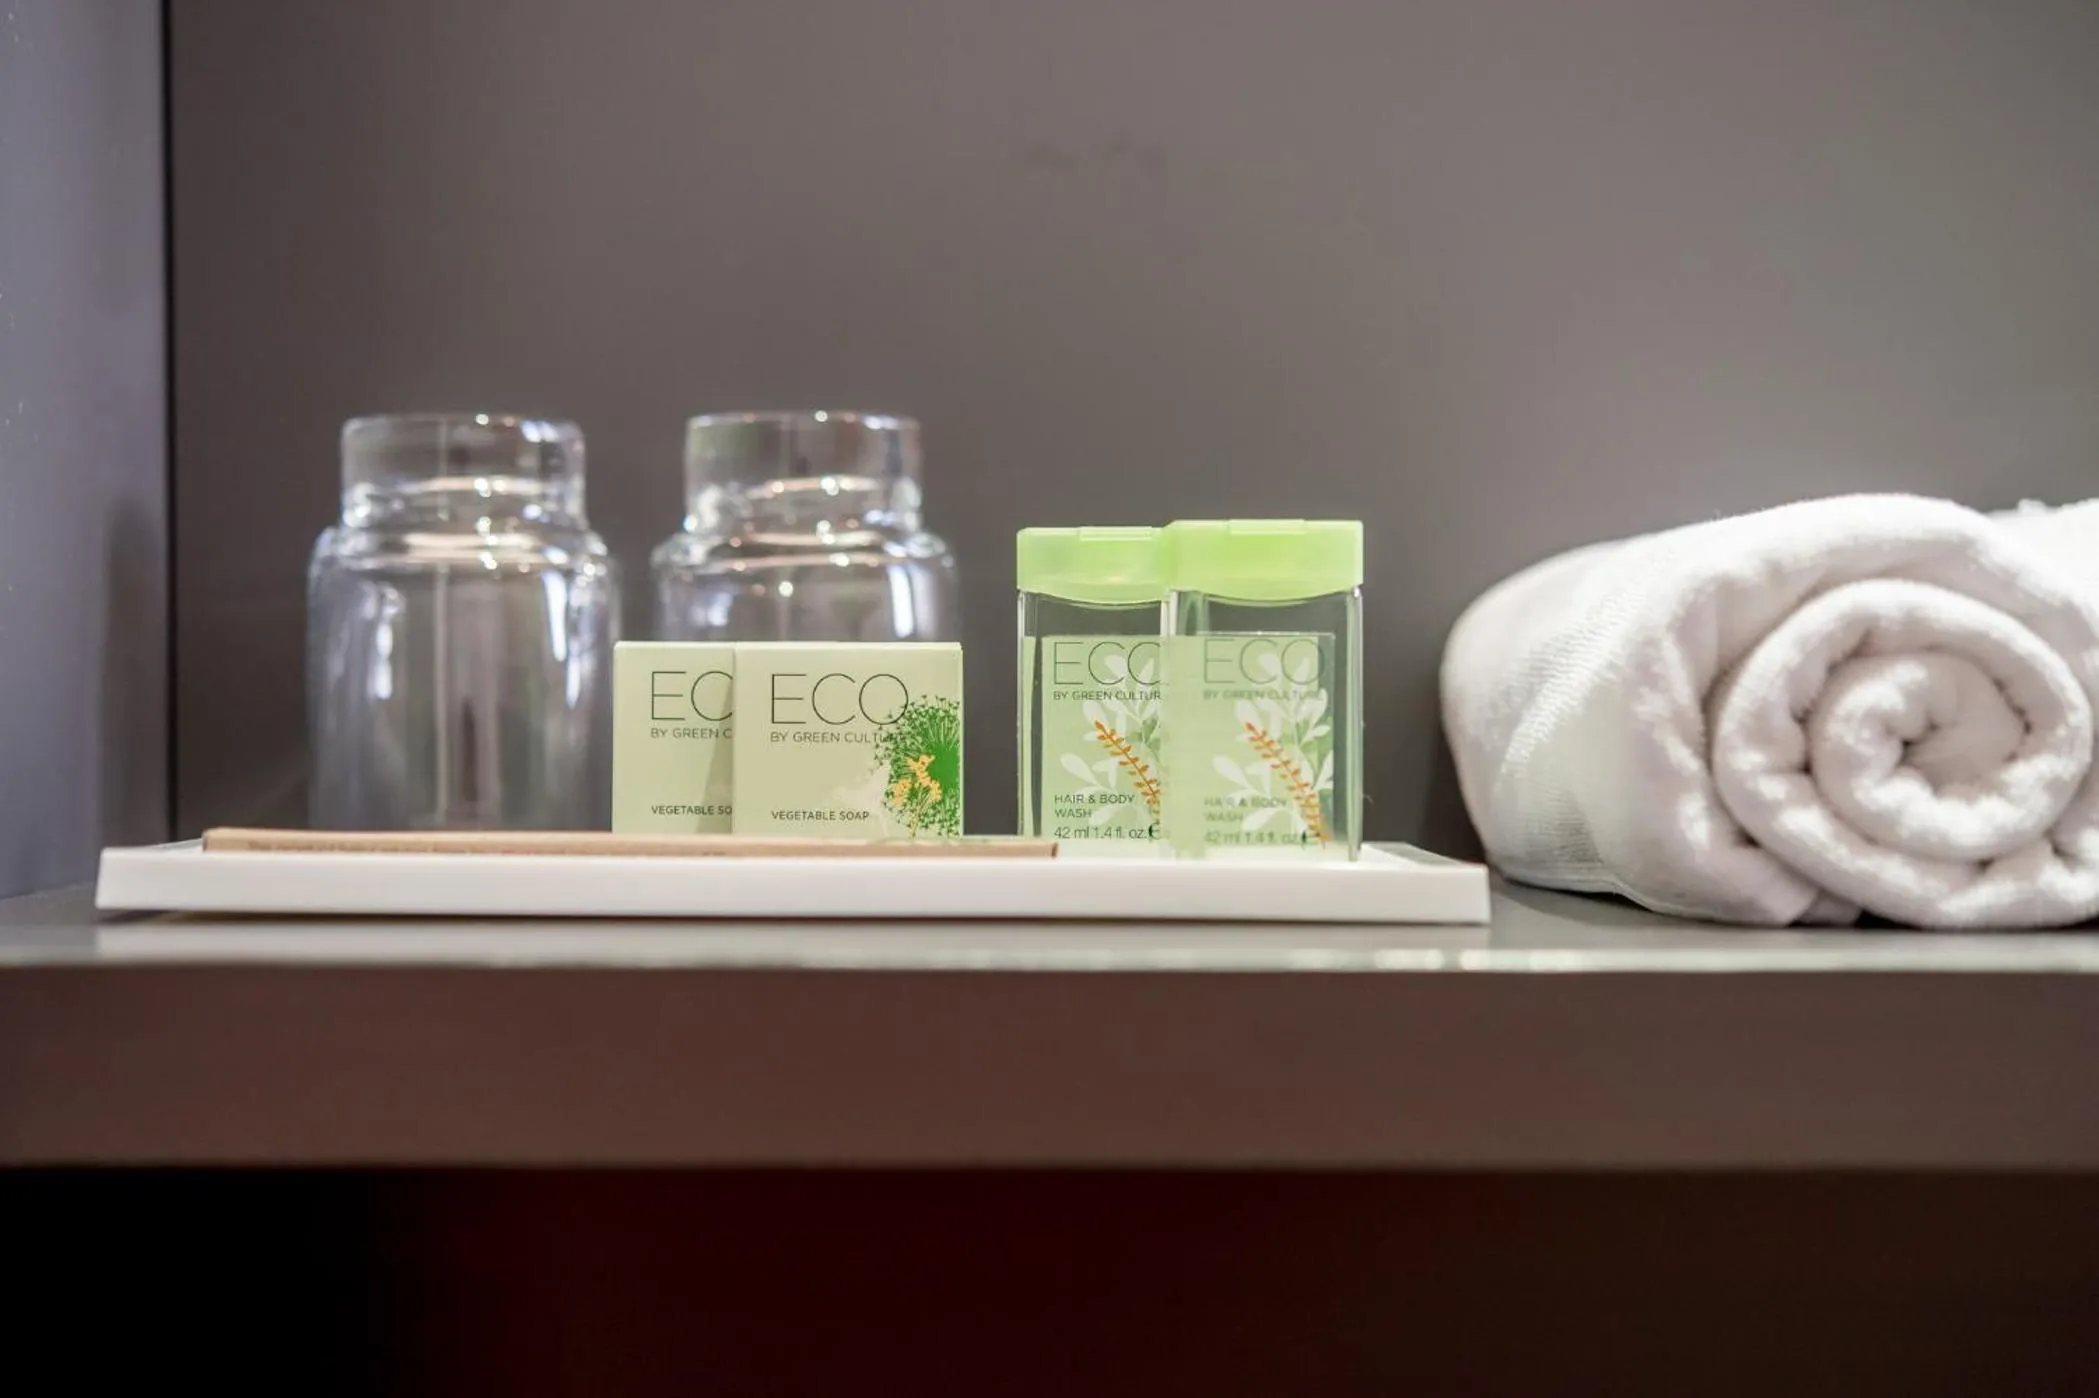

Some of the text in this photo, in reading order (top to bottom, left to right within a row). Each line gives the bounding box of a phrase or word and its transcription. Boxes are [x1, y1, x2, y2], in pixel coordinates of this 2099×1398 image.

[1203, 637, 1326, 685] ECO
[771, 672, 909, 726] ECO
[1053, 690, 1068, 701] BY
[1072, 690, 1113, 701] GREEN
[650, 727, 667, 739] BY
[672, 727, 719, 739] GREEN
[770, 731, 787, 743] BY
[792, 731, 840, 744] GREEN
[1053, 793, 1135, 805] HAIR & BODY
[651, 805, 713, 816] VEGETABLE
[771, 810, 870, 822] VEGETABLE SOAP
[1053, 808, 1093, 819] WASH
[1053, 826, 1071, 839] 42
[1074, 826, 1089, 839] ml
